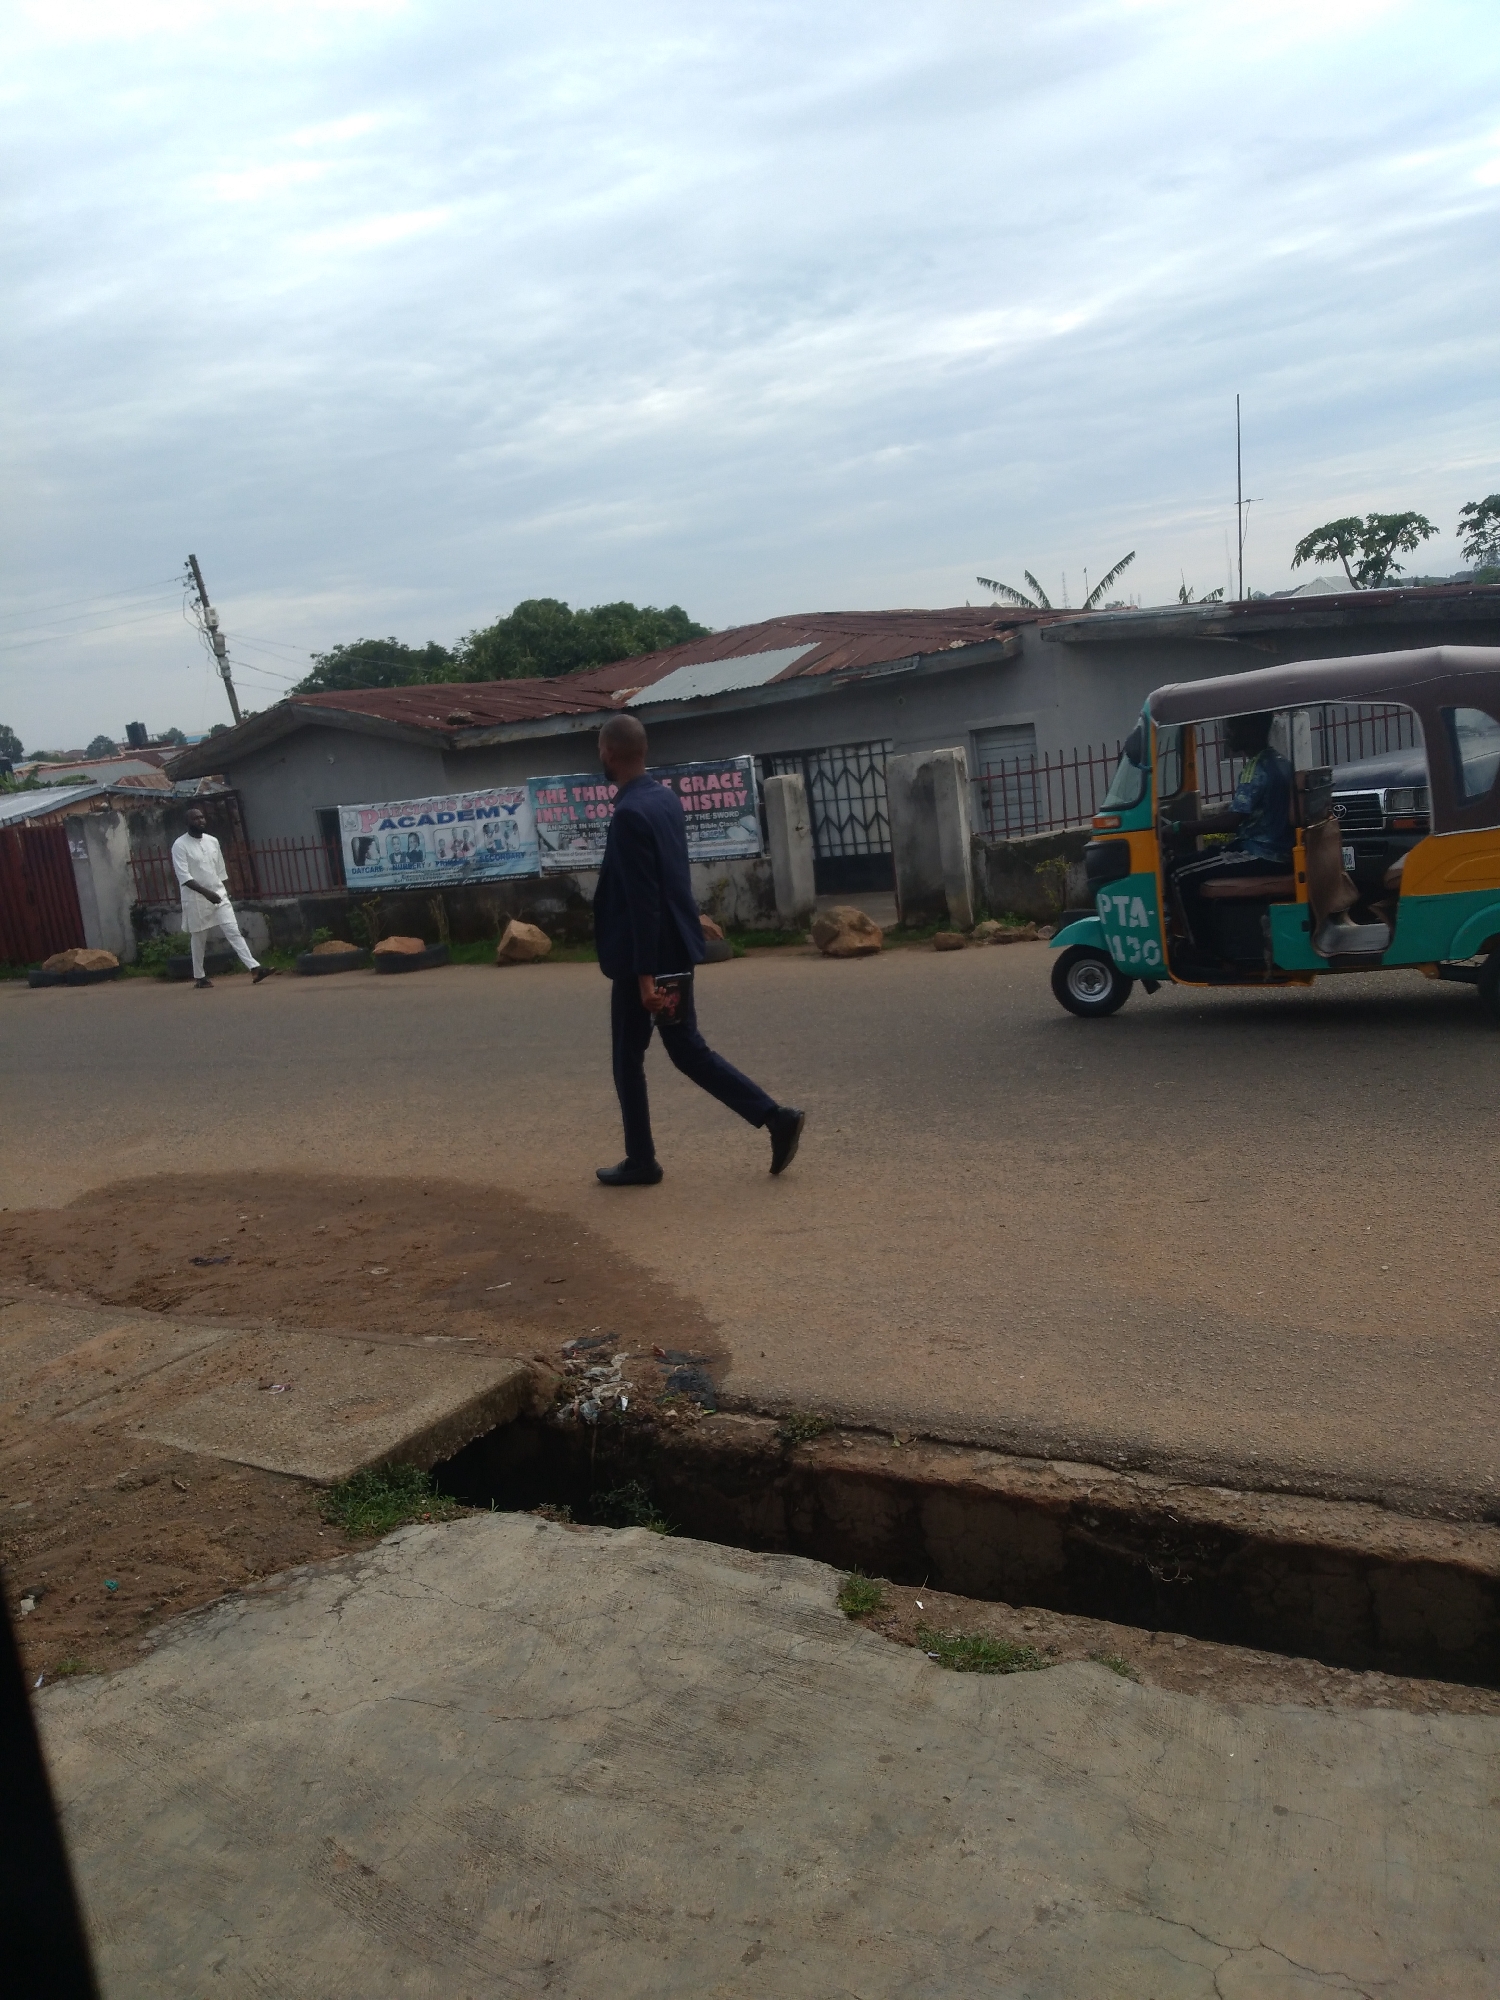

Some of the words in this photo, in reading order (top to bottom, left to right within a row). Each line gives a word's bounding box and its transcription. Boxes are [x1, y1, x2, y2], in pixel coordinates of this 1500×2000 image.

[536, 788, 568, 805] THE
[572, 784, 619, 802] THRO
[680, 772, 744, 793] GRACE
[358, 799, 457, 834] PRECIOUS
[462, 791, 525, 809] STONE
[378, 803, 522, 831] ACADEMY
[536, 805, 579, 823] INT'L
[585, 803, 616, 820] GOS
[680, 790, 748, 812] NISTRY
[351, 866, 384, 875] DAYCARE
